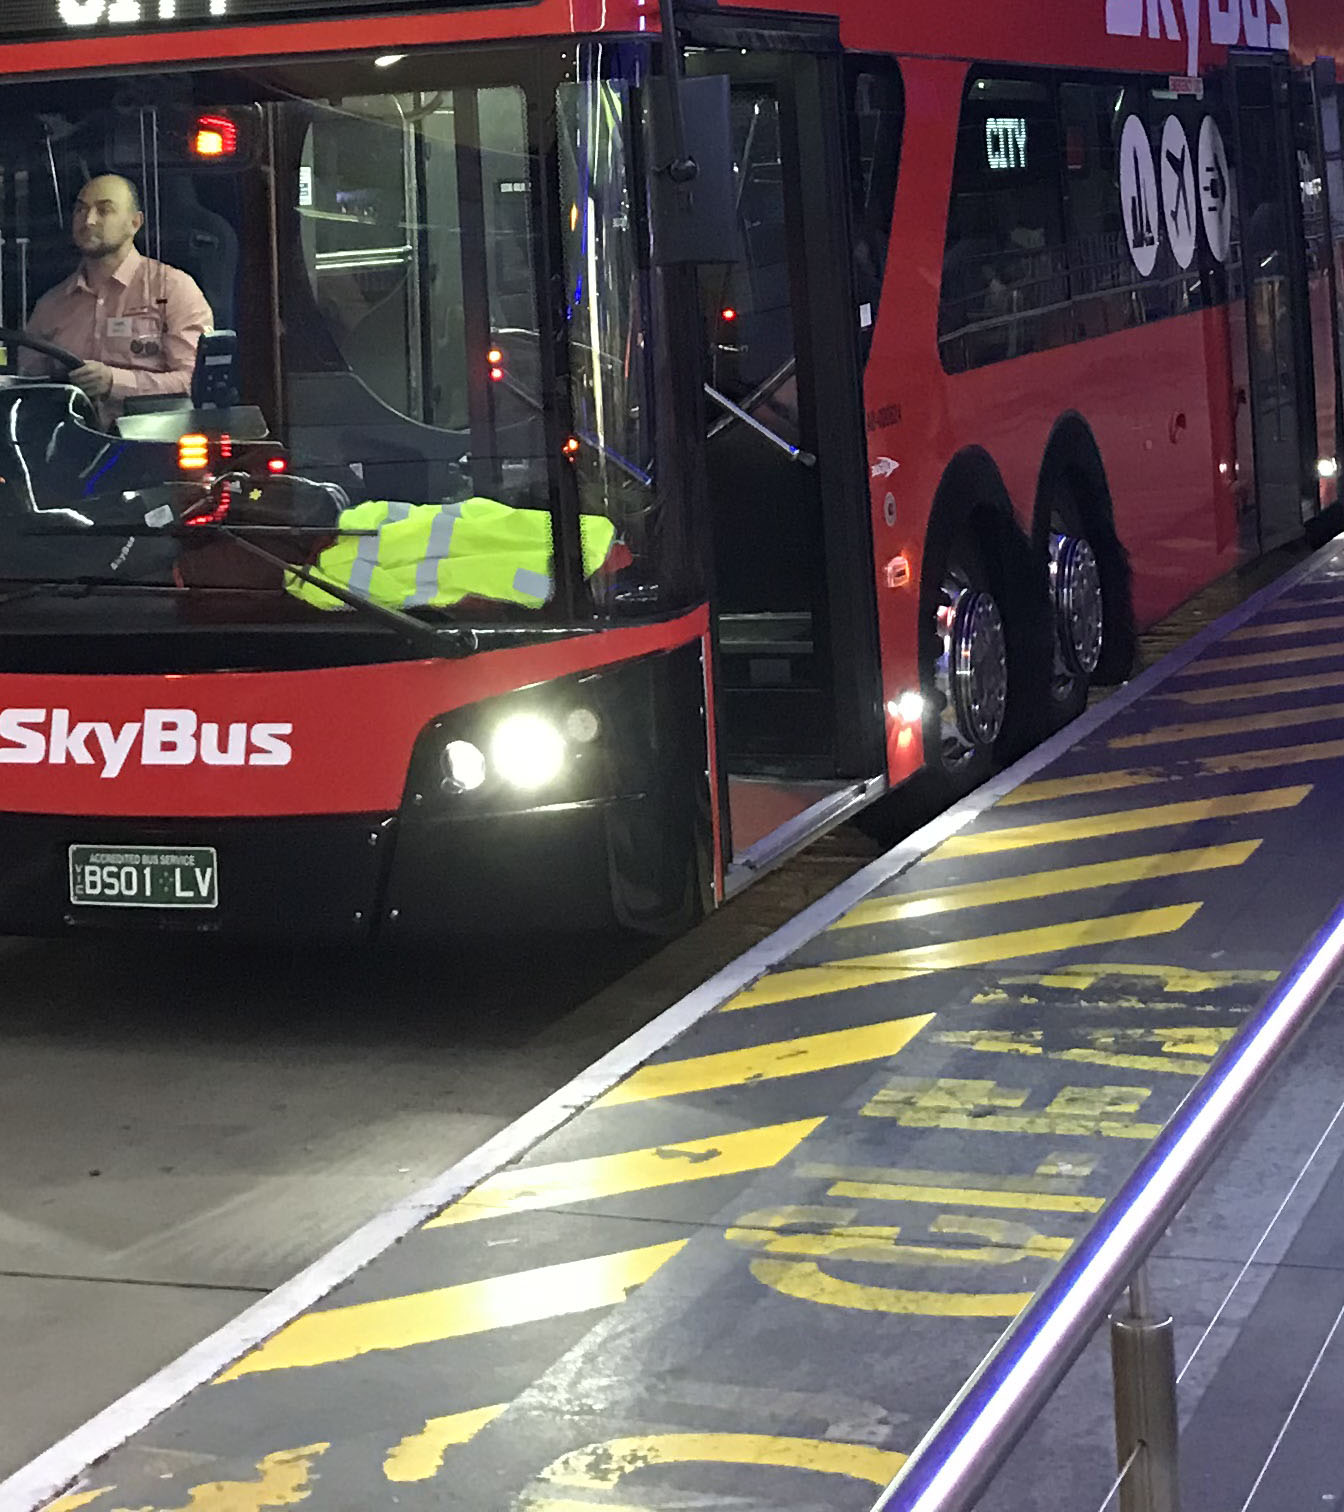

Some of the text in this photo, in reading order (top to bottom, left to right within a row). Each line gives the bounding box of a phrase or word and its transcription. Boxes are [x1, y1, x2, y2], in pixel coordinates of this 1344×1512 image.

[986, 118, 1026, 168] CITY
[89, 853, 195, 866] ACCREDITED BUS SERVICE
[175, 867, 212, 897] LV
